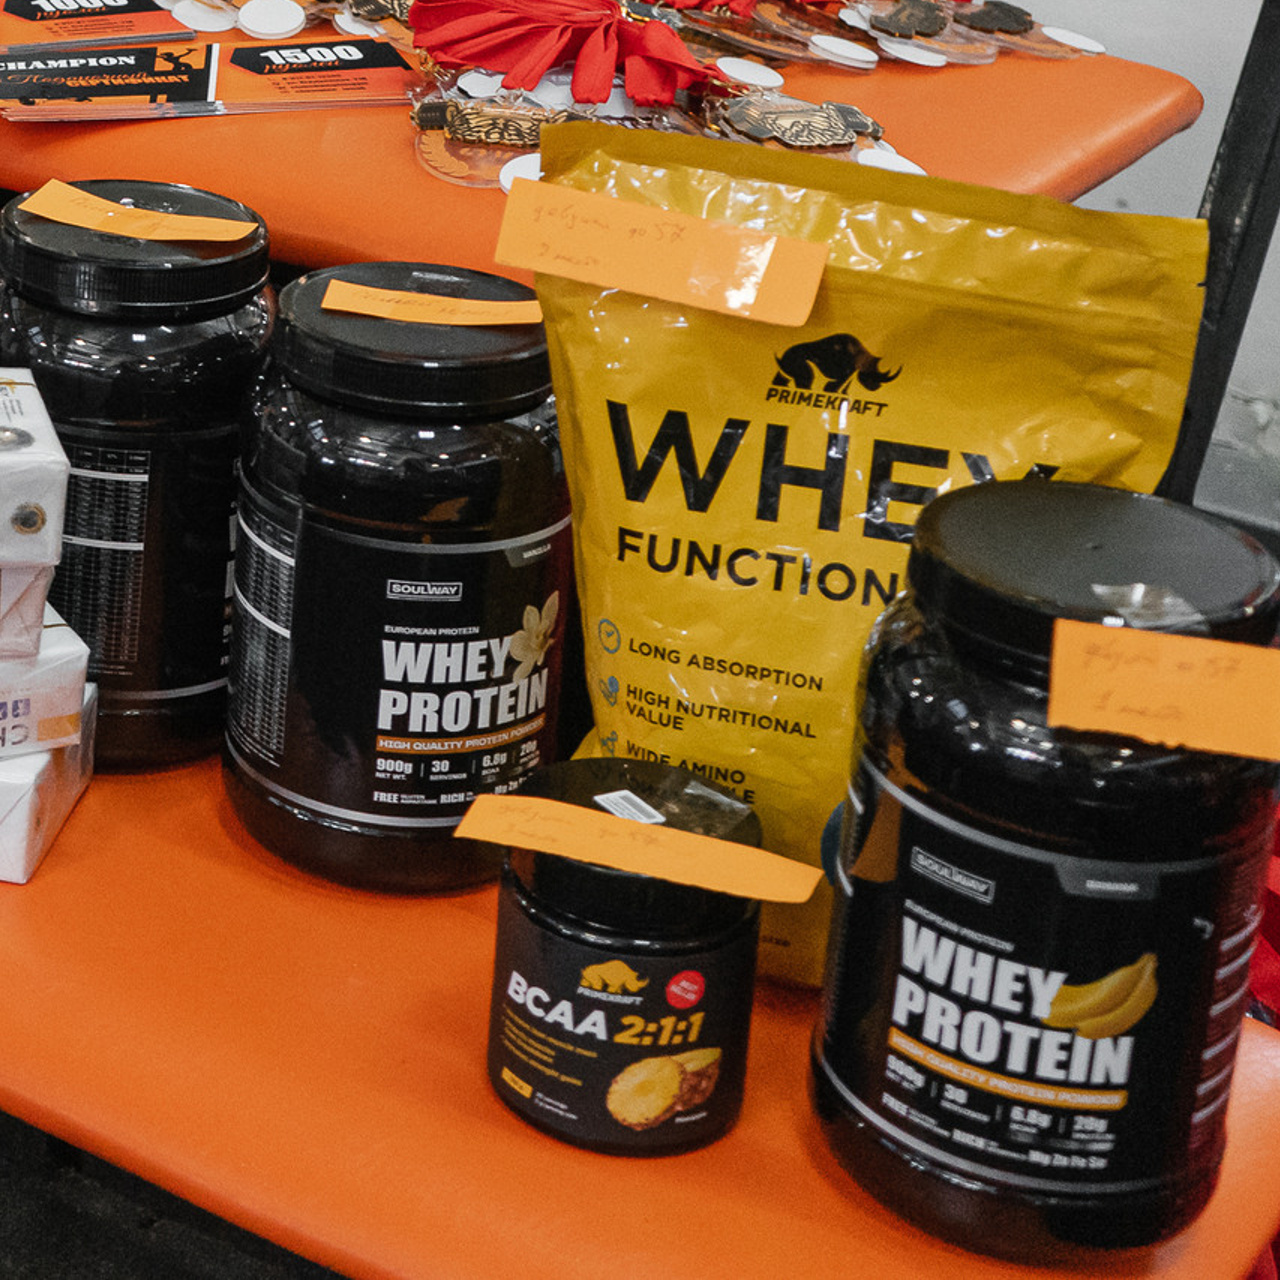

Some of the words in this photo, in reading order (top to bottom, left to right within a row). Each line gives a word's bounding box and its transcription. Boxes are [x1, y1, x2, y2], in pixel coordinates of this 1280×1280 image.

[259, 45, 364, 65] 1500
[606, 399, 1060, 544] WHE
[392, 583, 458, 596] SOULWAY
[384, 625, 437, 636] EUROPEAN
[438, 626, 480, 635] PROTEIN
[382, 635, 513, 684] WHEY
[628, 638, 681, 664] LONG
[687, 654, 823, 691] ABSORPTION
[377, 668, 549, 733] PROTEIN
[626, 684, 670, 709] HIGH
[676, 699, 817, 738] NUTRITIONAL
[626, 701, 685, 731] VALUE
[378, 740, 411, 750] HIGH
[413, 740, 463, 751] QUALITY
[465, 733, 509, 749] PROTEIN
[376, 758, 413, 774] 900g
[431, 760, 450, 773] 30
[482, 752, 508, 767] 6.8g
[677, 759, 746, 785] AMINO
[373, 791, 399, 803] FREE
[440, 792, 465, 803] RICH
[901, 915, 1068, 1021] WHEY
[506, 970, 609, 1041] BCAA
[613, 1011, 706, 1046] 2:1:1
[893, 974, 1135, 1085] PROTEIN
[925, 1051, 987, 1085] QUALITY
[988, 1076, 1056, 1101] PROTEIN
